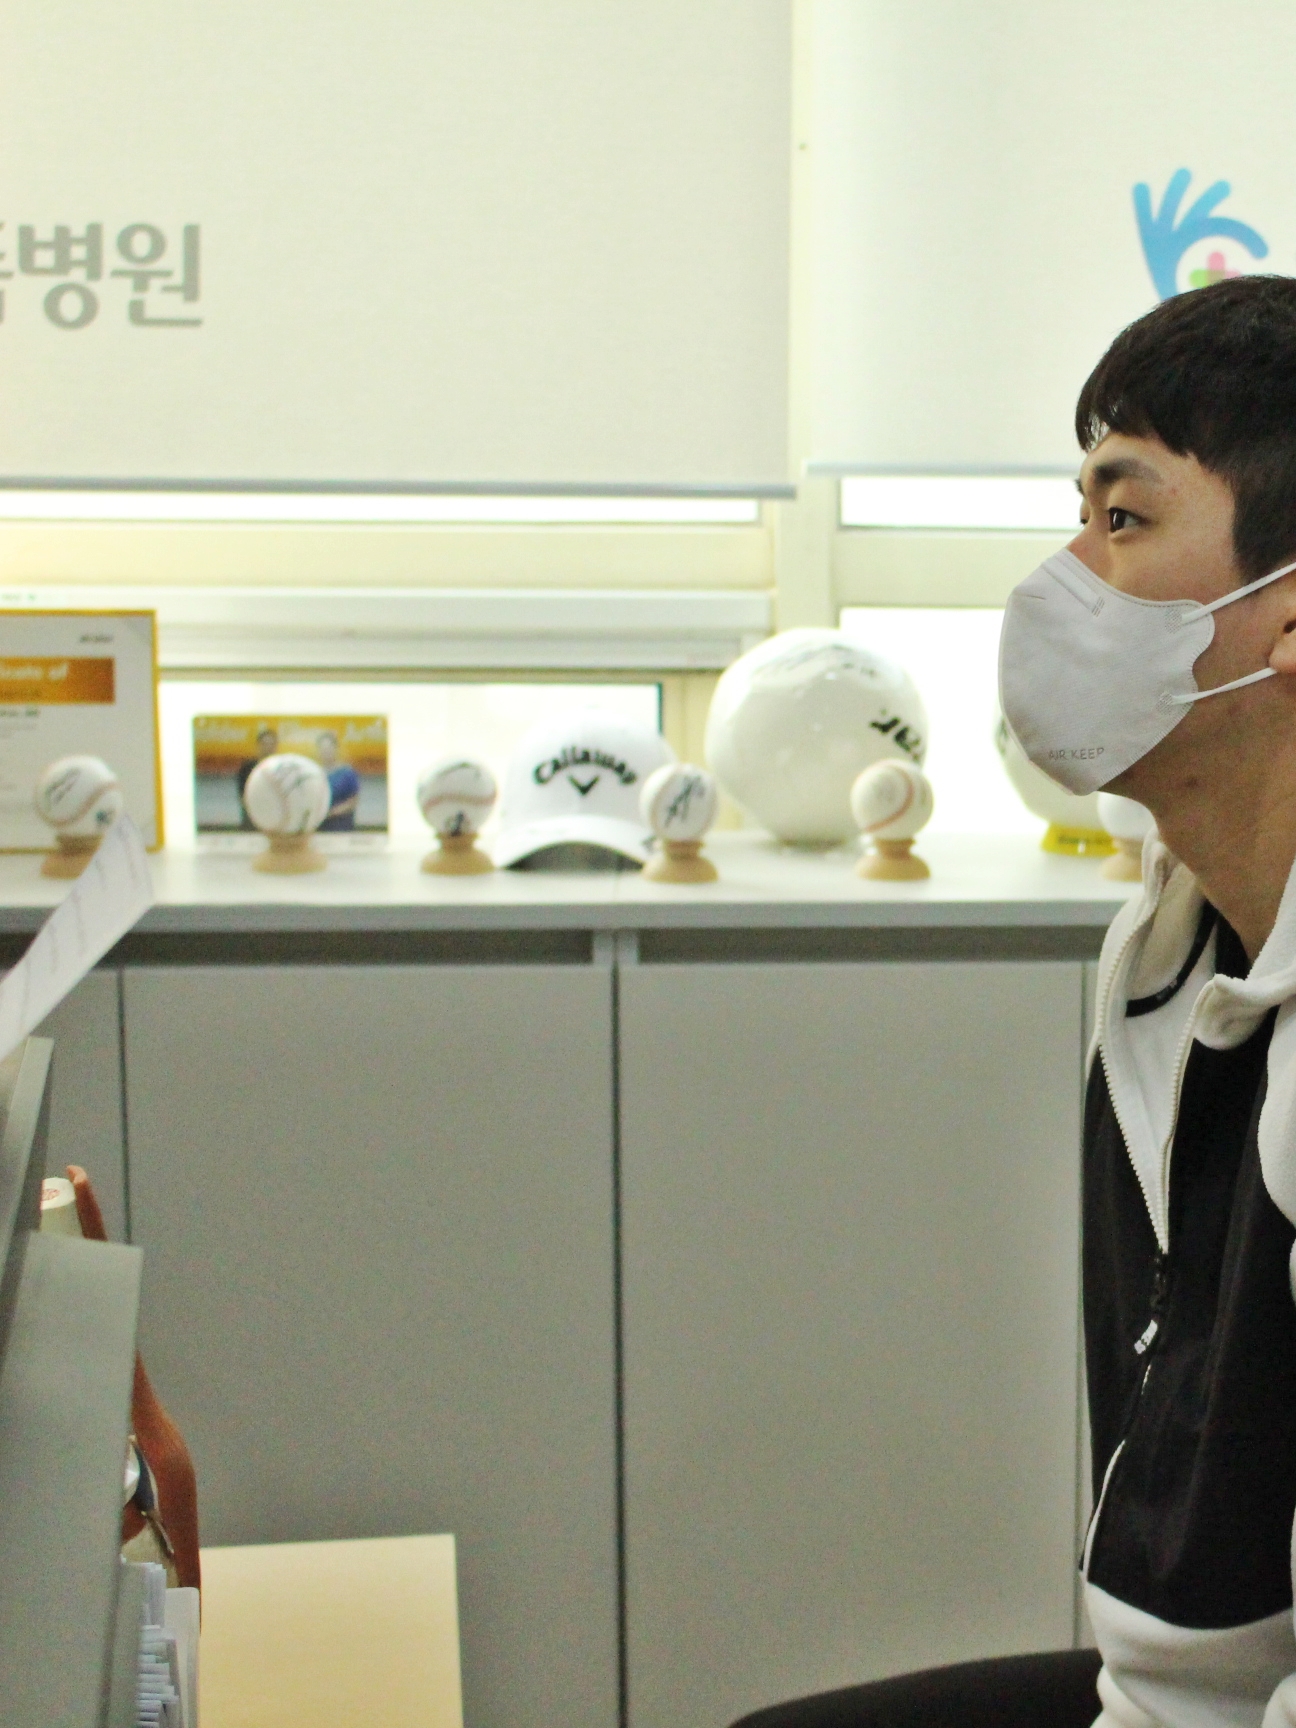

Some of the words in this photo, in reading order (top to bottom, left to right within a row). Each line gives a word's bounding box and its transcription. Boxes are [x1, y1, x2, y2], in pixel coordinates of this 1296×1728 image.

[0, 222, 203, 330] 병원
[532, 744, 638, 785] Callaway
[1049, 749, 1067, 761] AIR
[1070, 747, 1105, 760] KEEP
